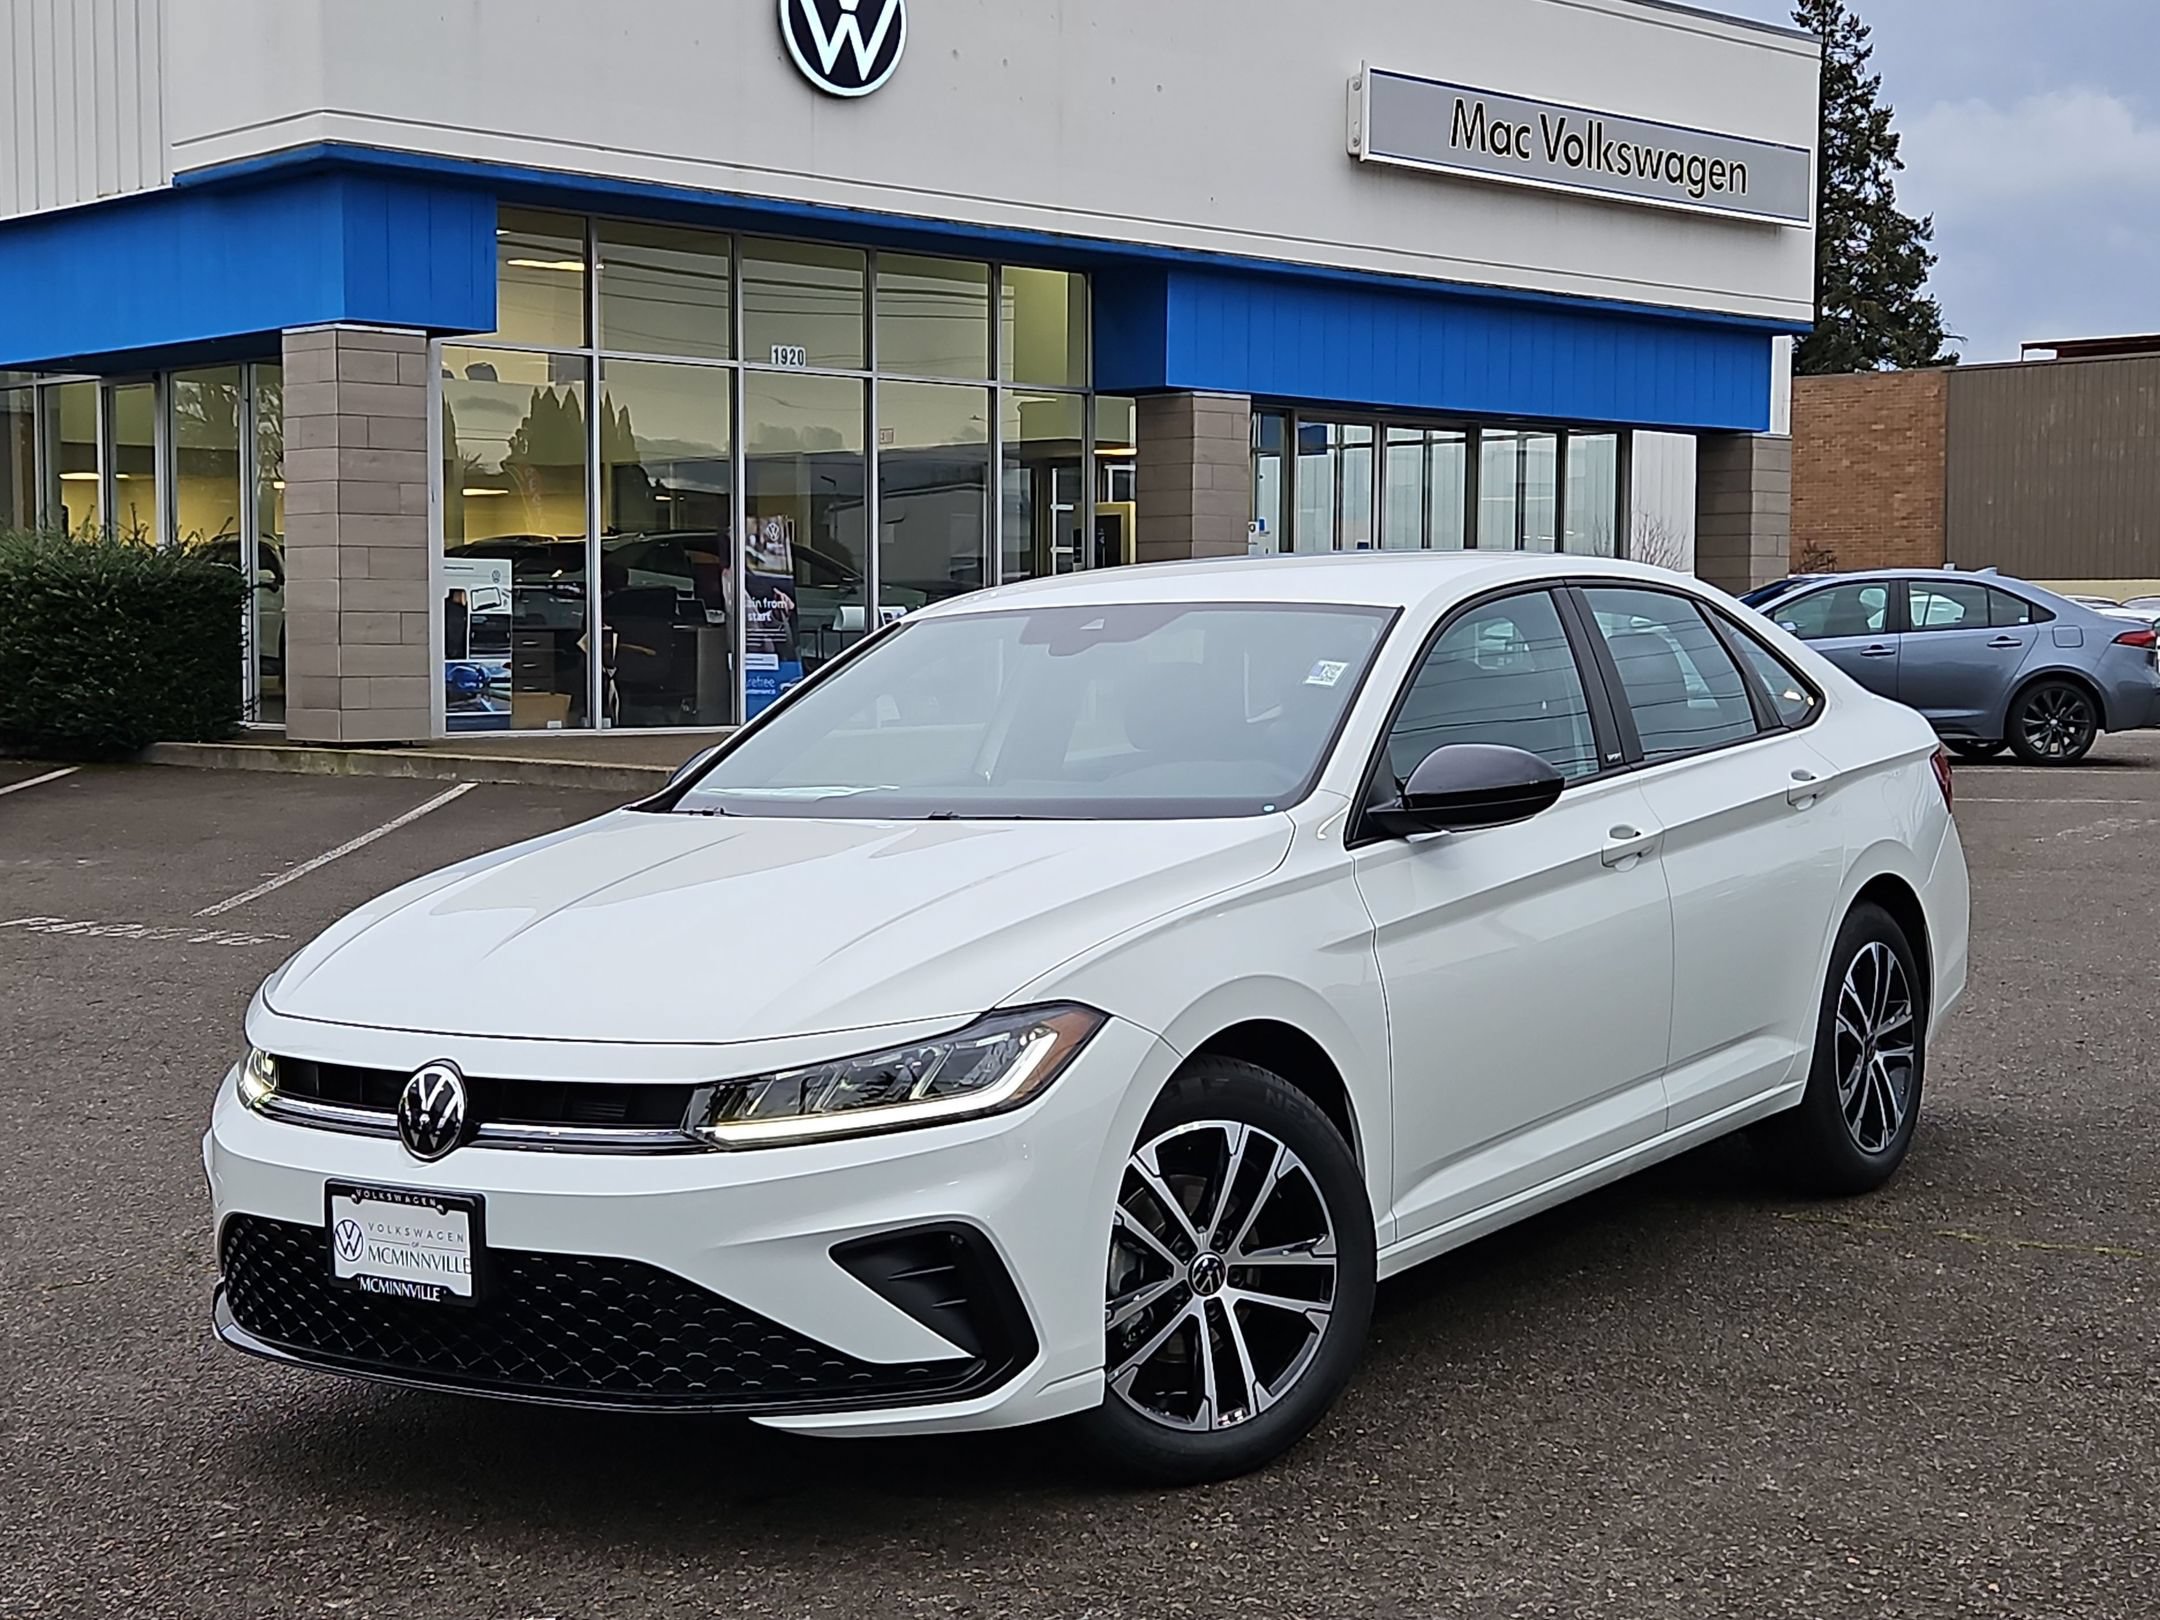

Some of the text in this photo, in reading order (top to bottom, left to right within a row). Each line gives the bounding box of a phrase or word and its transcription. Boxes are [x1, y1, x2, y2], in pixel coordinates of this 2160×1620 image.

[1450, 98, 1747, 199] Mac Volkswagen
[773, 346, 804, 366] 1920
[763, 597, 786, 609] from
[355, 1189, 438, 1207] VOLKSWAGEN
[367, 1222, 465, 1243] VOLKSWAGEN
[368, 1245, 472, 1274] MCMINNVILLE
[358, 1276, 441, 1302] MCMINNVILLE
